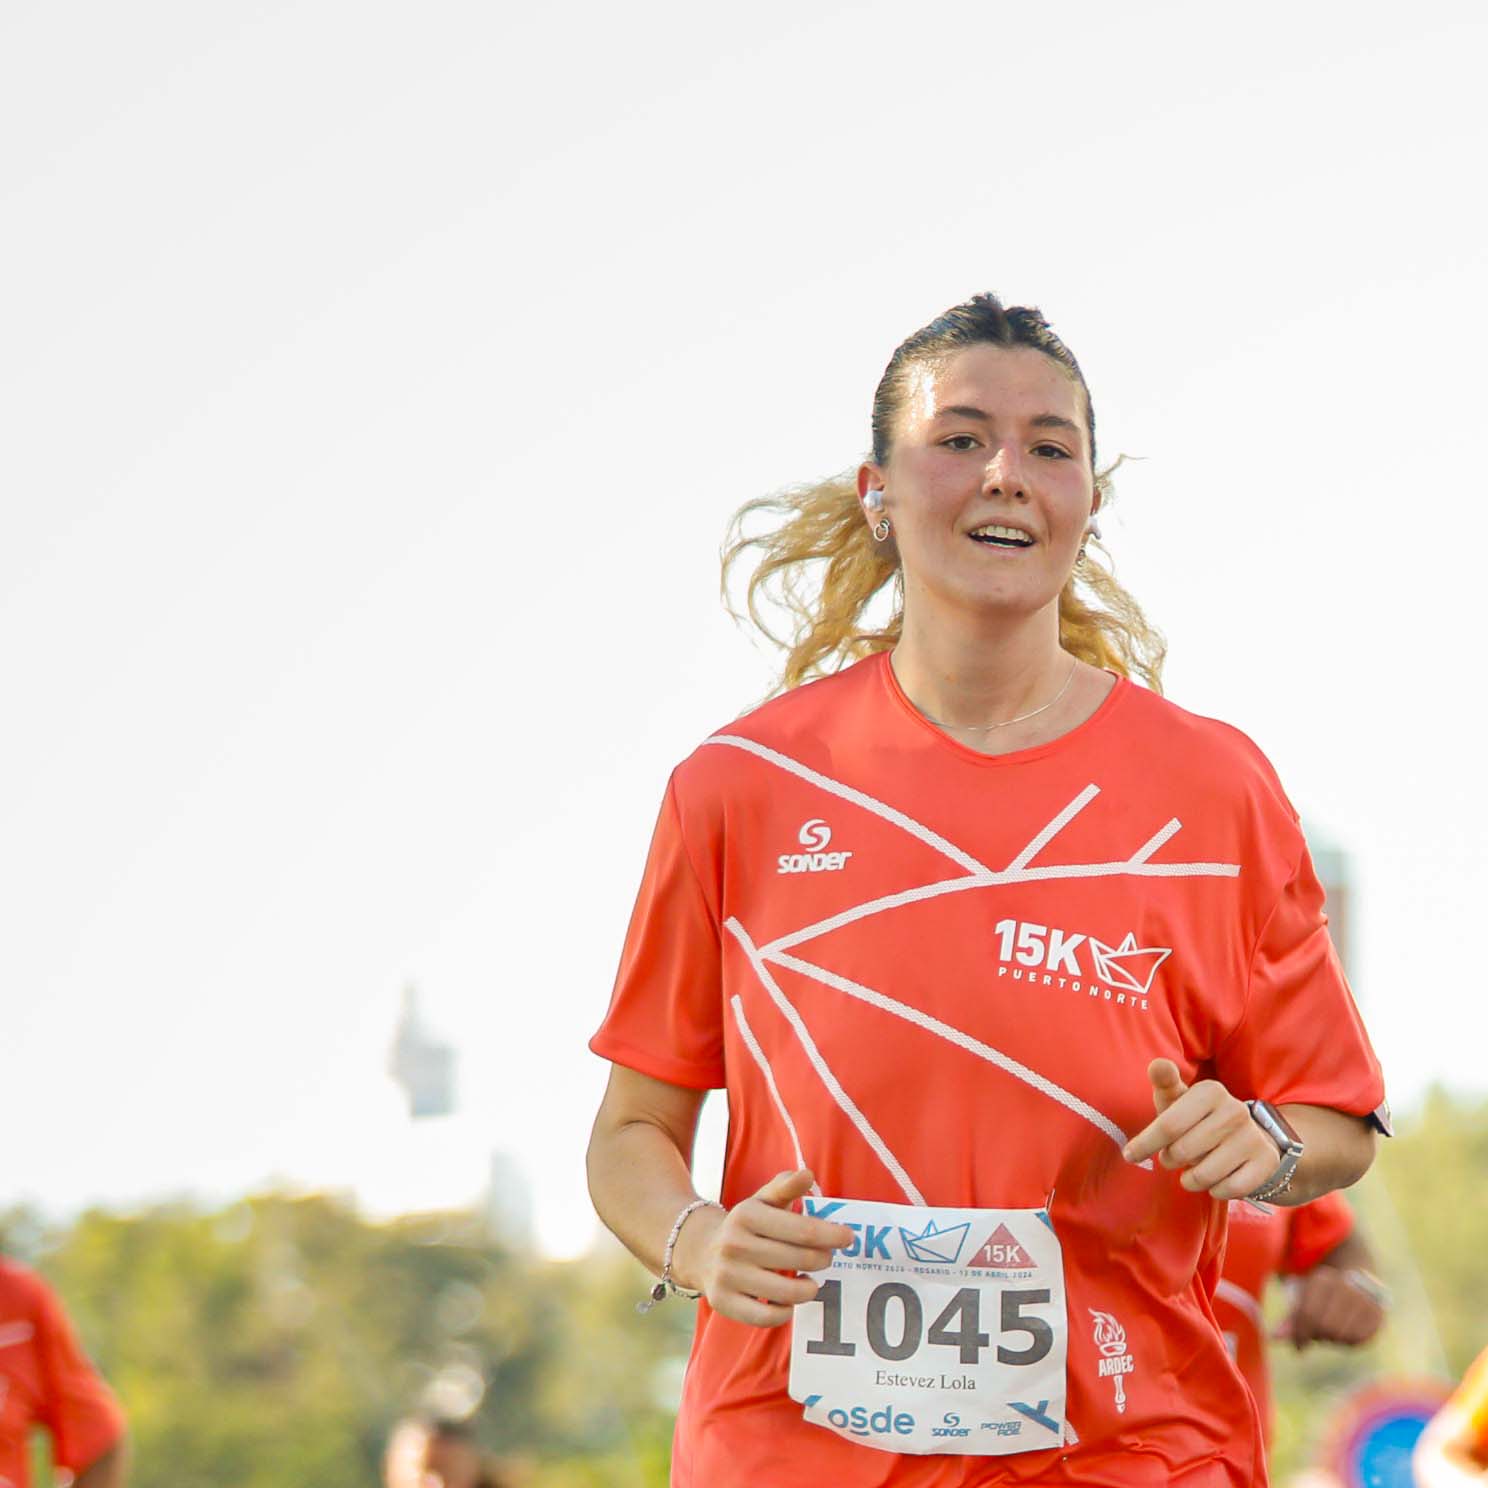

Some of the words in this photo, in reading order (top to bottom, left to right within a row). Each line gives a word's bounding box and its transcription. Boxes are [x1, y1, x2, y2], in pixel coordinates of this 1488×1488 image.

[994, 918, 1088, 977] 15K
[998, 966, 1081, 992] PUERTO
[1089, 985, 1148, 1010] NORTE
[832, 1222, 894, 1260] 5K
[983, 1244, 1022, 1264] 15K
[832, 1262, 854, 1270] ERTO
[856, 1263, 882, 1273] NORTE
[914, 1267, 951, 1276] ROSARIO
[972, 1270, 983, 1278] DE
[985, 1271, 1010, 1279] ABRIL
[806, 1279, 1055, 1366] 1045
[1098, 1354, 1135, 1377] ARDEC
[875, 1370, 936, 1389] Estevez
[940, 1374, 976, 1390] Lola
[980, 1421, 1021, 1431] POWER
